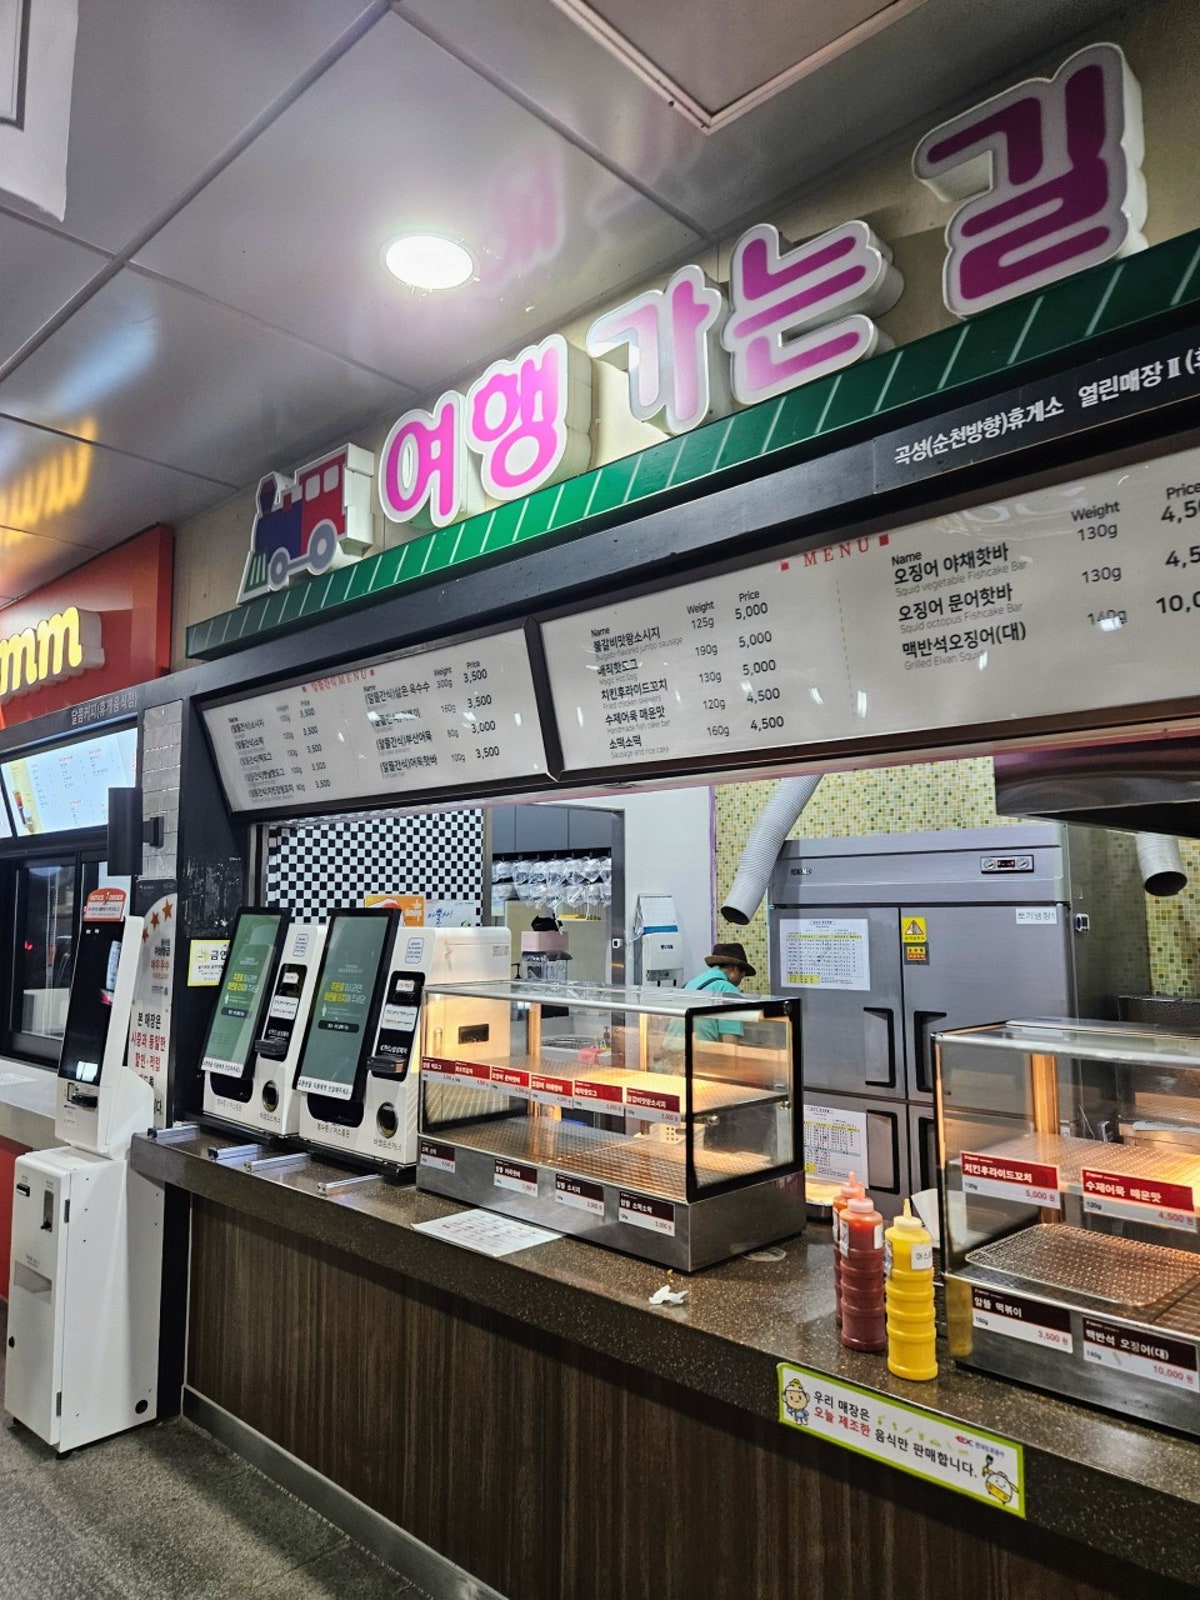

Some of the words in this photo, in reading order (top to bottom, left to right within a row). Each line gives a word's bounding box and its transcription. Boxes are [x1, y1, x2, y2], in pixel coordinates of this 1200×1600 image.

[380, 338, 567, 525] 여행
[590, 222, 882, 431] 가는
[917, 48, 1122, 312] 길
[894, 396, 1064, 465] 곡성(순천방향)휴게소
[1078, 361, 1164, 407] 열린매장
[891, 551, 922, 566] Name
[1070, 501, 1121, 522] Weight
[1166, 483, 1200, 500] Price
[803, 538, 870, 567] MENU
[894, 559, 939, 584] 오징어
[943, 542, 1009, 573] 야채핫바
[1077, 524, 1118, 541] 130g
[1161, 500, 1200, 524] 4,5
[895, 585, 920, 597] Squid
[921, 574, 966, 591] vegetable
[968, 564, 1009, 580] Fishcake
[1011, 560, 1028, 572] Bar
[899, 598, 944, 622] 오징어
[948, 582, 1013, 613] 문어핫바
[1081, 567, 1122, 583] 130g
[591, 627, 610, 637] Name
[687, 601, 714, 614] Weight
[739, 590, 760, 602] Price
[691, 617, 714, 629] 125g
[735, 602, 768, 620] 5,000
[900, 622, 925, 634] Squid
[926, 616, 962, 629] octopus
[964, 607, 1004, 620] Fishcake
[1007, 602, 1023, 613] Bar
[695, 644, 718, 656] 190g
[739, 630, 772, 648] 5,000
[902, 621, 1026, 658] 맥반석오징어(대)
[463, 668, 488, 684] 3,500
[601, 678, 668, 701] 치킨후라이드꼬치
[699, 671, 722, 683] 130g
[742, 659, 776, 676] 5,000
[905, 659, 932, 671] Grilled
[467, 694, 492, 709] 3,500
[605, 709, 638, 726] 수제어묵
[639, 705, 666, 720] 매운맛
[703, 698, 726, 710] 120g
[746, 687, 780, 704] 4,500
[471, 720, 496, 734] 3,000
[609, 735, 642, 750] 소떡소떡
[707, 725, 730, 737] 160g
[750, 715, 784, 732] 4,500
[476, 746, 500, 760] 3,500
[964, 1163, 1033, 1183] 치킨후라이드꼬치
[1026, 1190, 1047, 1200] 5,000
[1085, 1181, 1126, 1197] 수제어묵
[1129, 1188, 1162, 1203] 매운맛
[1158, 1212, 1184, 1223] 4,500
[995, 1302, 1022, 1318] 떡볶이
[1038, 1330, 1060, 1342] 3,500
[1085, 1329, 1116, 1346] 맥반석
[1120, 1338, 1169, 1360] 오징어(대)
[1153, 1365, 1184, 1381] 10,000
[813, 1391, 834, 1409] 우리
[838, 1399, 870, 1422] 매장은
[813, 1406, 834, 1424] 오늘
[838, 1415, 872, 1437] 제조한
[875, 1429, 909, 1452] 음식만
[913, 1442, 978, 1478] 판매합니다.
